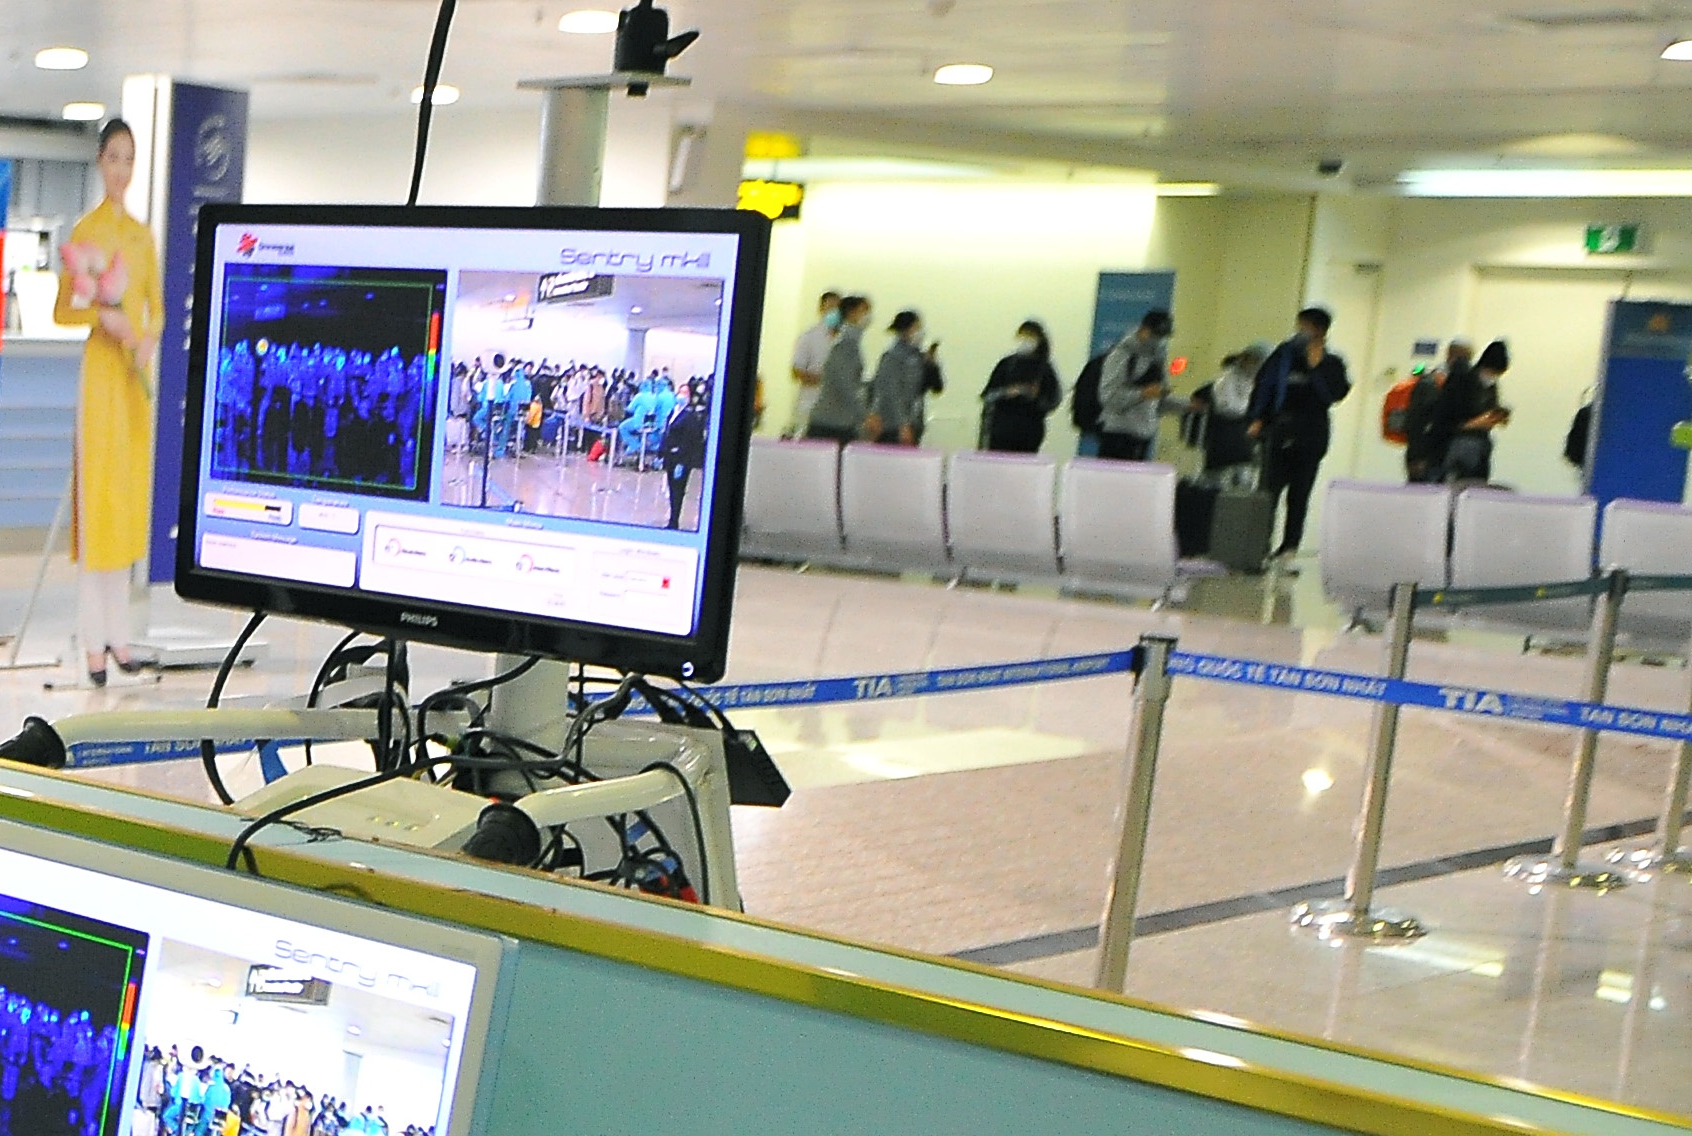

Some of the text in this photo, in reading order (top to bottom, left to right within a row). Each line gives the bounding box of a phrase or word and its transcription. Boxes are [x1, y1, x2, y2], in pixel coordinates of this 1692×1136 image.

[560, 247, 655, 273] Sentry
[400, 611, 439, 627] PHILIPS
[852, 675, 895, 700] TIA
[1439, 686, 1505, 716] TIA
[274, 939, 376, 988] Sentry
